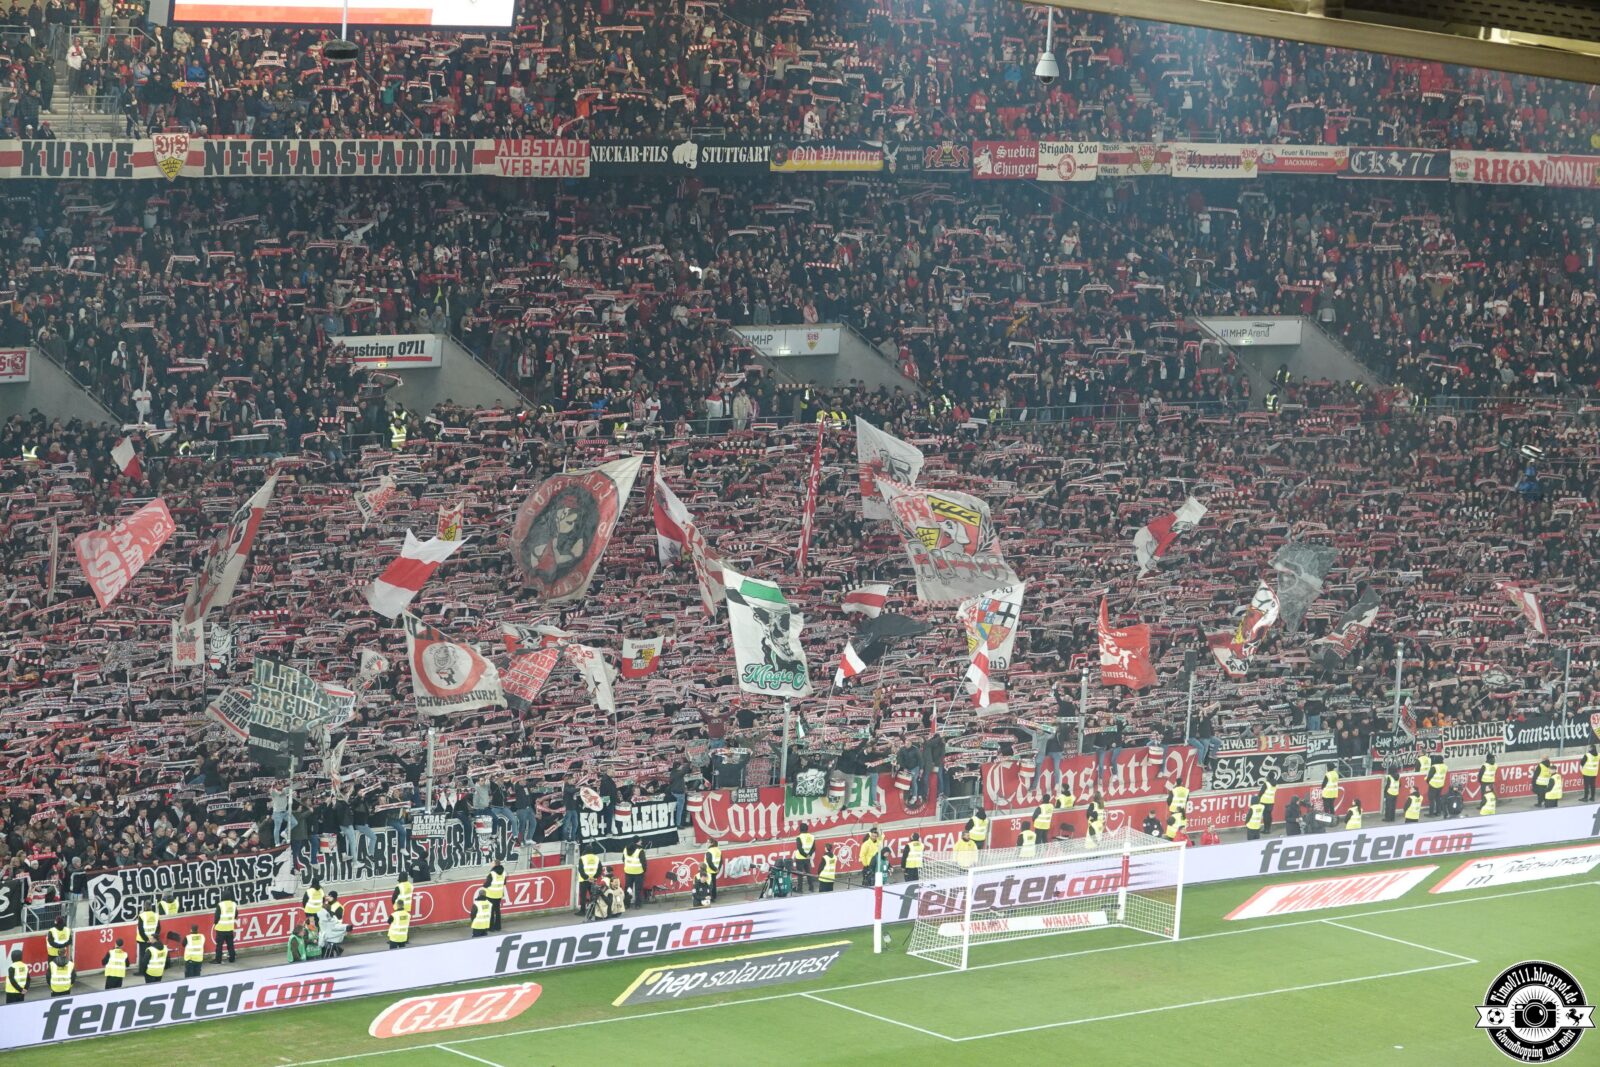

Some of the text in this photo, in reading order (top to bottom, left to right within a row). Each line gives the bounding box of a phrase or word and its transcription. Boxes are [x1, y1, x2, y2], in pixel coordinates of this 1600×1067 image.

[498, 139, 590, 157] ALBSTADT
[590, 145, 771, 163] NECKAR-FILS STUTTGART
[791, 145, 817, 165] Old
[821, 145, 880, 166] Warriors
[996, 144, 1036, 159] Suebia
[1039, 142, 1099, 156] Brigada Loca
[21, 140, 133, 176] KURVE
[204, 140, 476, 176] NECKARSTADION
[499, 158, 586, 176] VFB-FANS
[1284, 159, 1318, 168] BACKNANG
[1409, 152, 1436, 176] 77
[1548, 159, 1594, 187] DONAU
[751, 334, 774, 345] MHP
[1230, 329, 1248, 338] MHP
[398, 340, 425, 356] 0711
[1444, 742, 1504, 759] STUTTGART
[1405, 777, 1415, 788] 36
[1010, 818, 1021, 831] 35
[1216, 814, 1230, 825] der
[1259, 832, 1473, 873] fenster.com
[118, 854, 274, 896] HOOLIGANS
[898, 871, 1130, 919] fenster.com
[1042, 913, 1091, 928] WINAMAX
[100, 928, 114, 943] 33
[494, 919, 754, 973] fenster.com
[646, 950, 841, 998] hep solarinvest
[42, 976, 335, 1041] fenster.com
